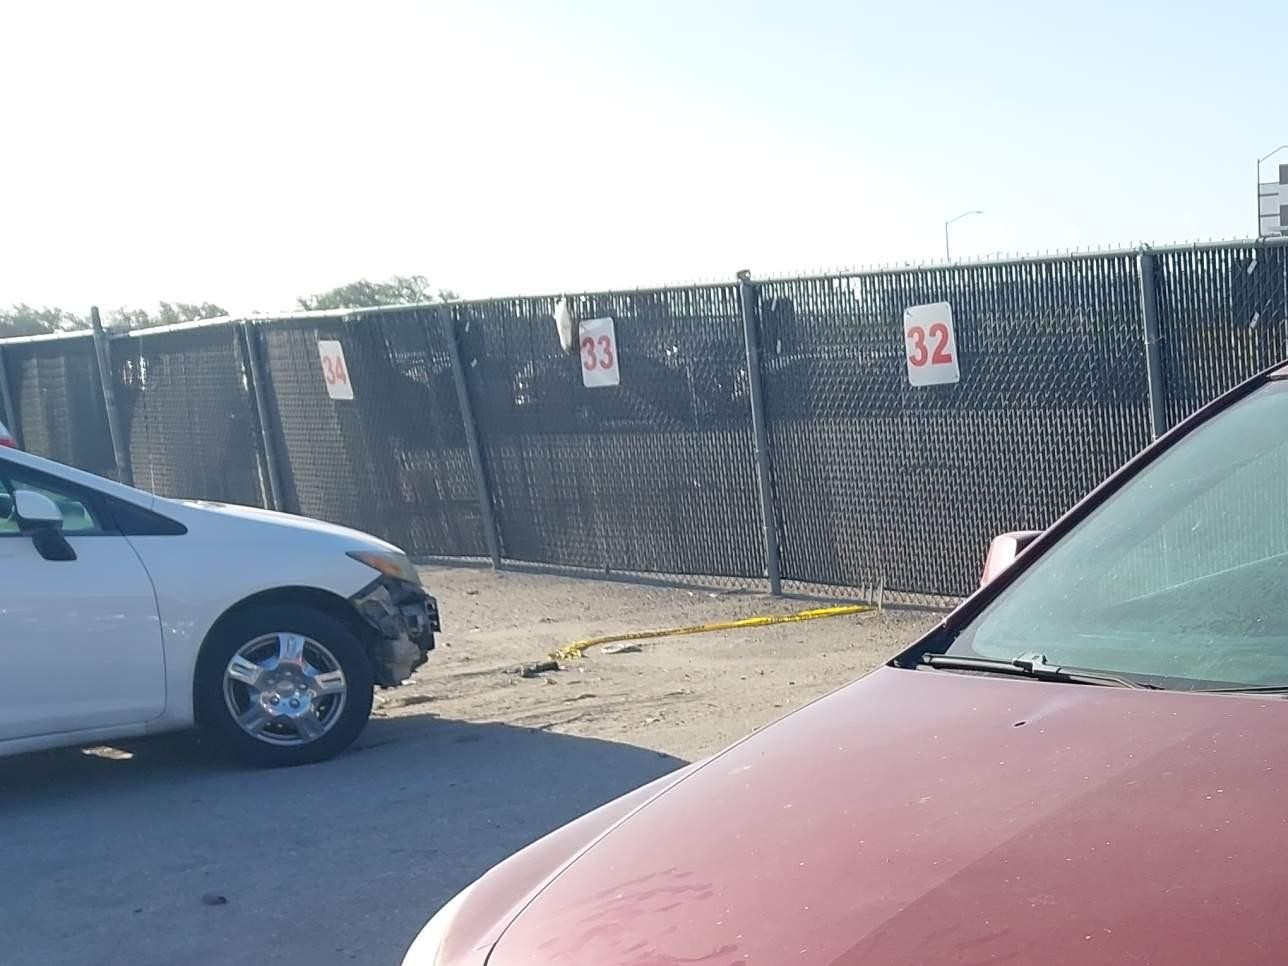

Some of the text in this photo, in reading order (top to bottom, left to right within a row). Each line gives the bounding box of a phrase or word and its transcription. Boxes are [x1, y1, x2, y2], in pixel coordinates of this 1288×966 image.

[582, 335, 615, 370] 33
[907, 323, 952, 367] 32
[322, 356, 347, 385] 34
